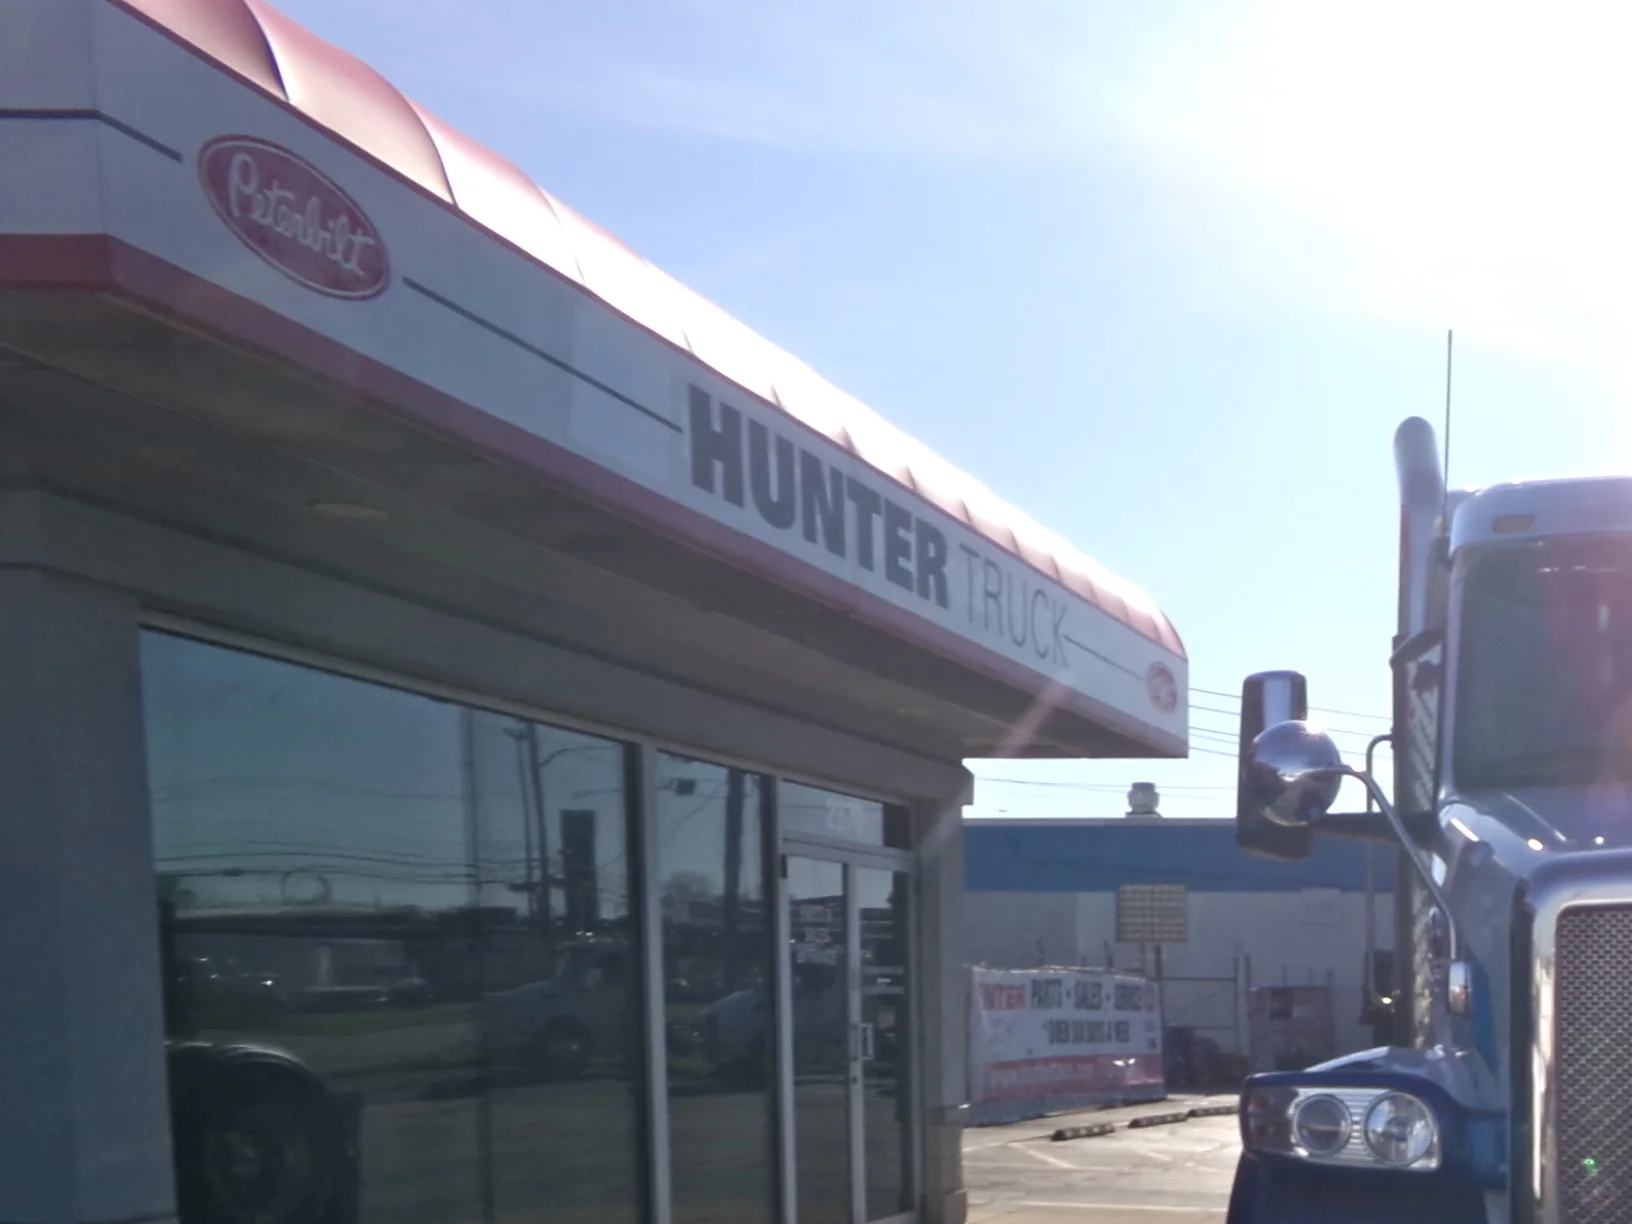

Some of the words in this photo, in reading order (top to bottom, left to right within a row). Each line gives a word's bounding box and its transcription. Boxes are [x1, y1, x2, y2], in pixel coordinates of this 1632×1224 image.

[228, 151, 375, 277] Peterbilt
[688, 382, 949, 611] HUNTER
[959, 542, 1070, 670] TRUCK
